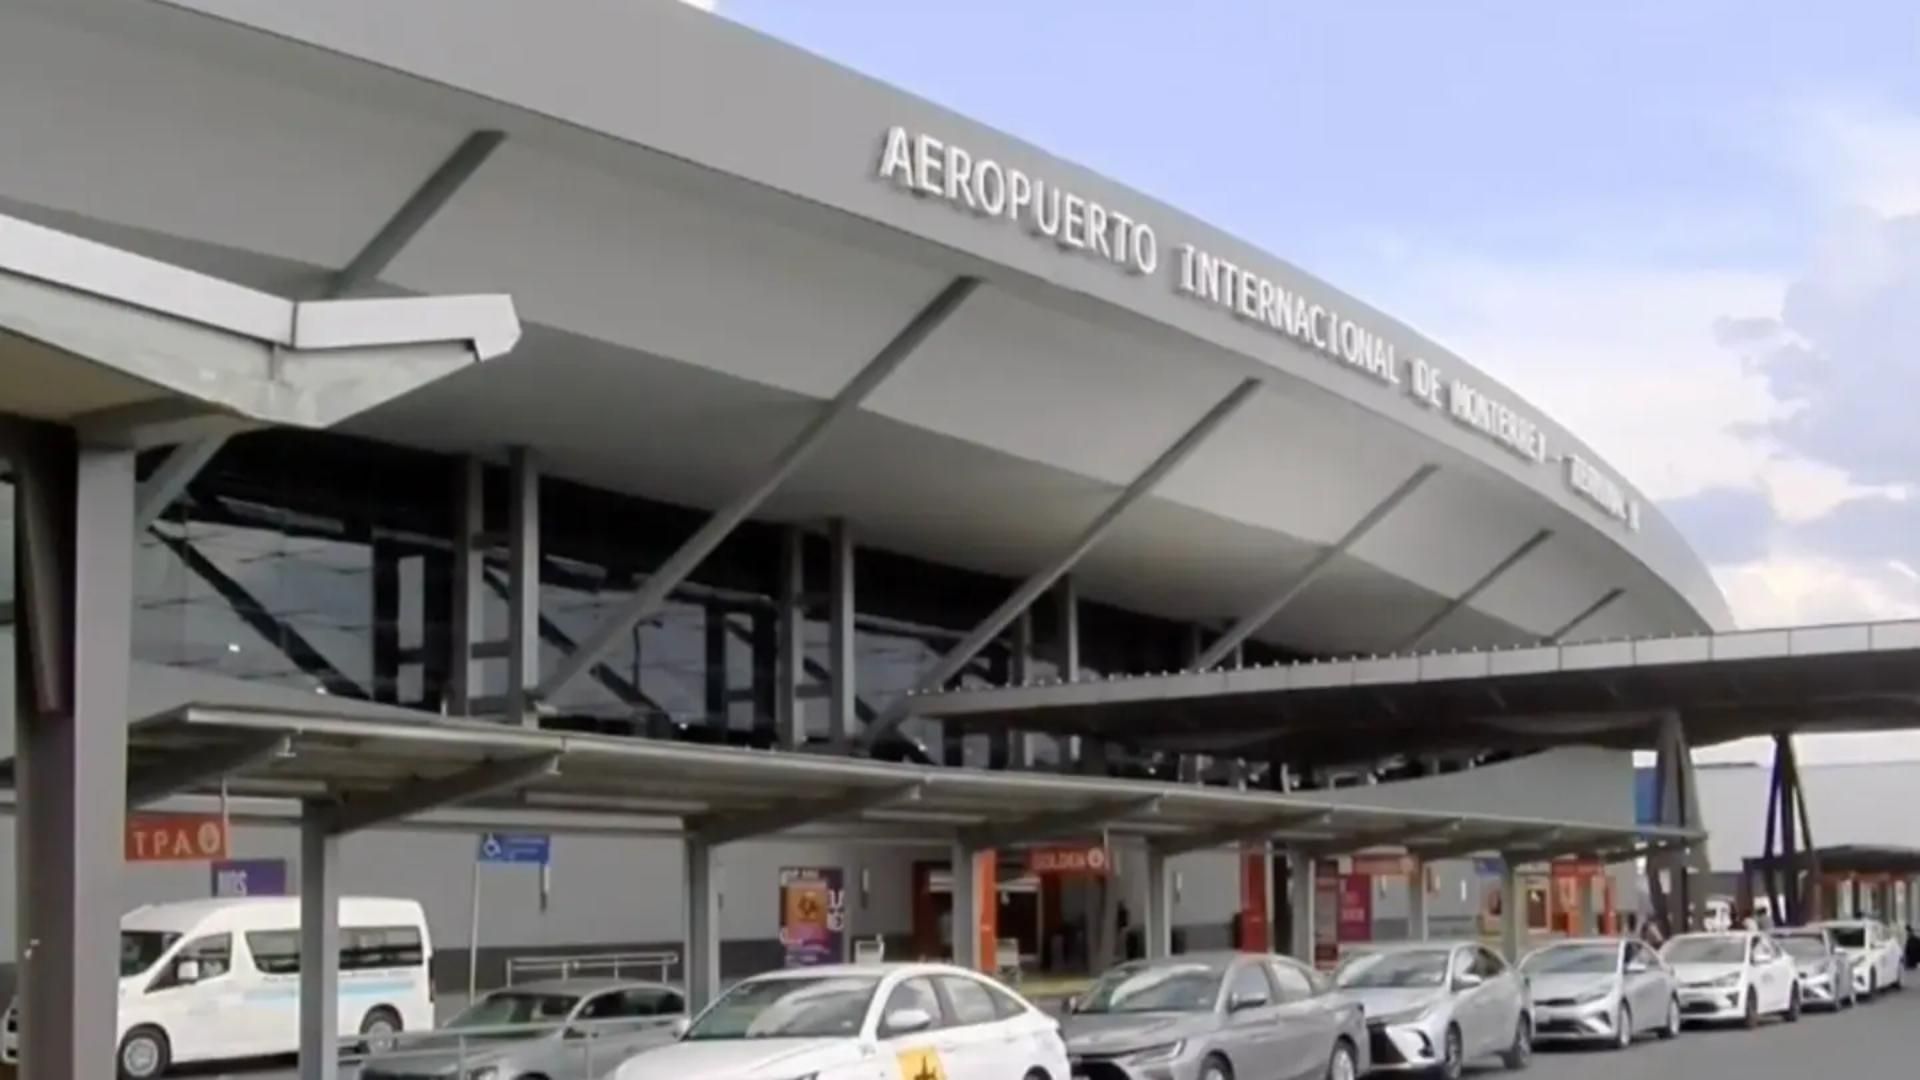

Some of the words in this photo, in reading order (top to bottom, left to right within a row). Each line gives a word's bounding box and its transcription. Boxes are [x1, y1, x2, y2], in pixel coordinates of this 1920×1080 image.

[879, 125, 1157, 274] AEROPUERTO
[1181, 242, 1400, 384] INTERNACIONAL
[1412, 358, 1443, 408] DE
[132, 829, 193, 857] TPA
